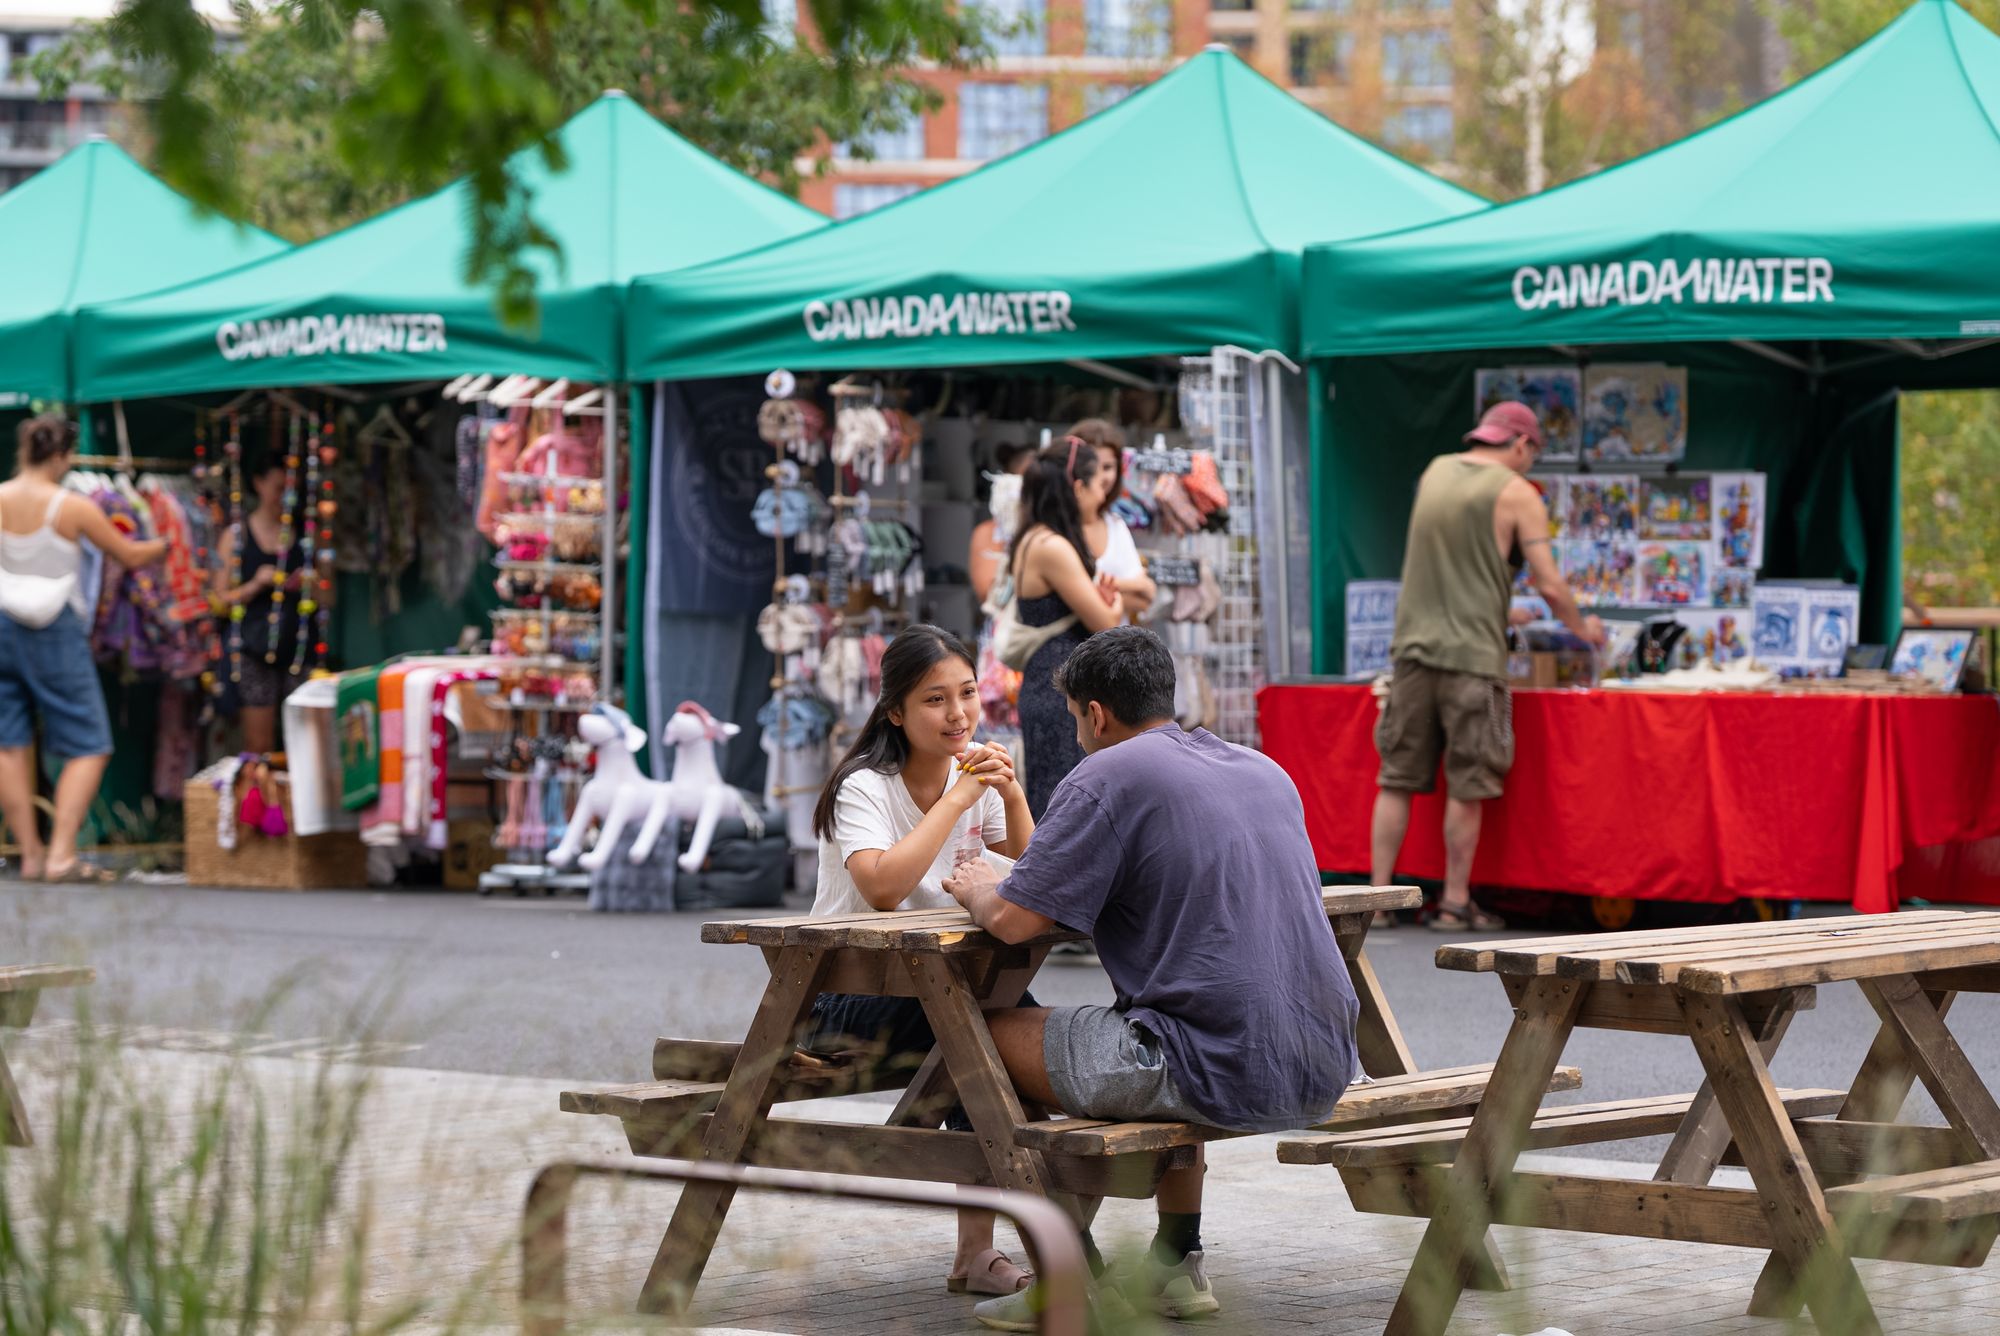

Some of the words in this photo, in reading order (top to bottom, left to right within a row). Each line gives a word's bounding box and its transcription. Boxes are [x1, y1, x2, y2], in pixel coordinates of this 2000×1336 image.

[1511, 258, 1683, 311] CANADA
[1682, 257, 1835, 304] WATER
[803, 293, 950, 342] CANADA
[944, 290, 1077, 335] WATER
